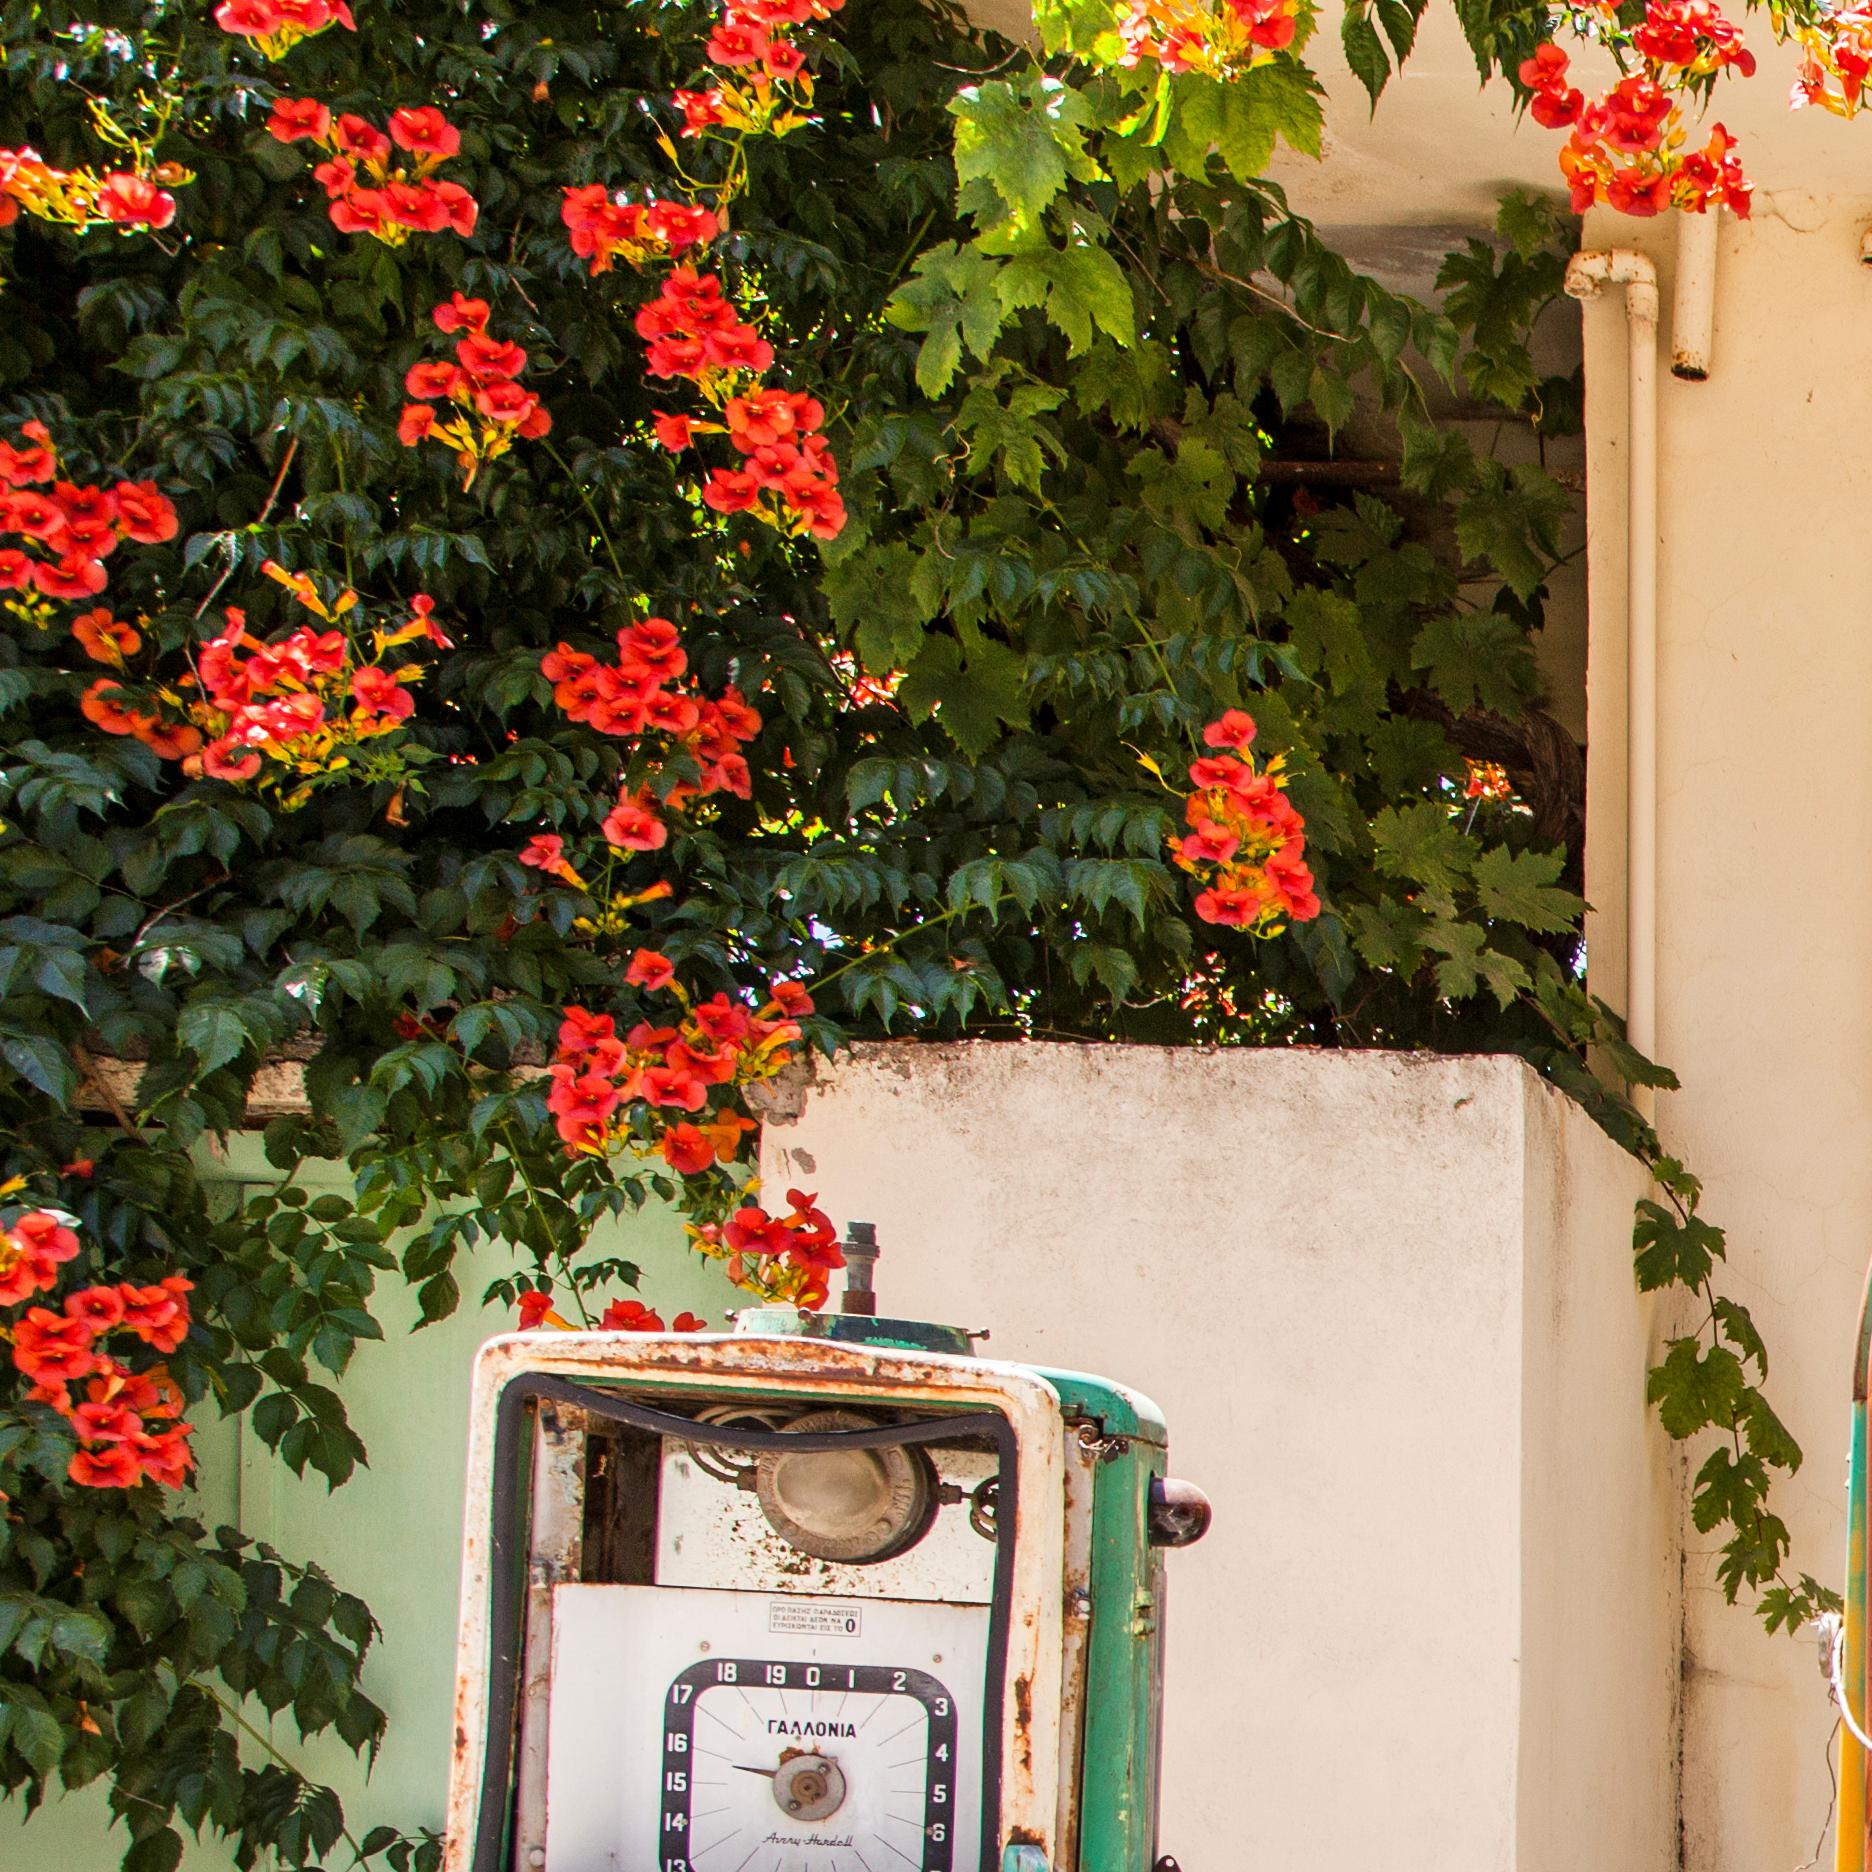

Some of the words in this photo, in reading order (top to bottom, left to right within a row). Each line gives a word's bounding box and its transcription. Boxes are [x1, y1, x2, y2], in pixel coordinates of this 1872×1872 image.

[845, 1618, 856, 1633] 0
[717, 1662, 738, 1683] 18
[766, 1664, 787, 1685] 19
[805, 1666, 820, 1687] 0
[848, 1669, 855, 1688] 1
[892, 1671, 907, 1691] 2
[672, 1684, 693, 1704] 17
[934, 1698, 949, 1717] 3
[767, 1719, 857, 1739] ΓΑΛΛΟΝΙΑ
[667, 1733, 688, 1753] 16
[935, 1743, 949, 1762] 4
[666, 1772, 687, 1792] 15
[933, 1784, 947, 1804] 5
[665, 1812, 686, 1832] 14
[931, 1823, 946, 1842] 6
